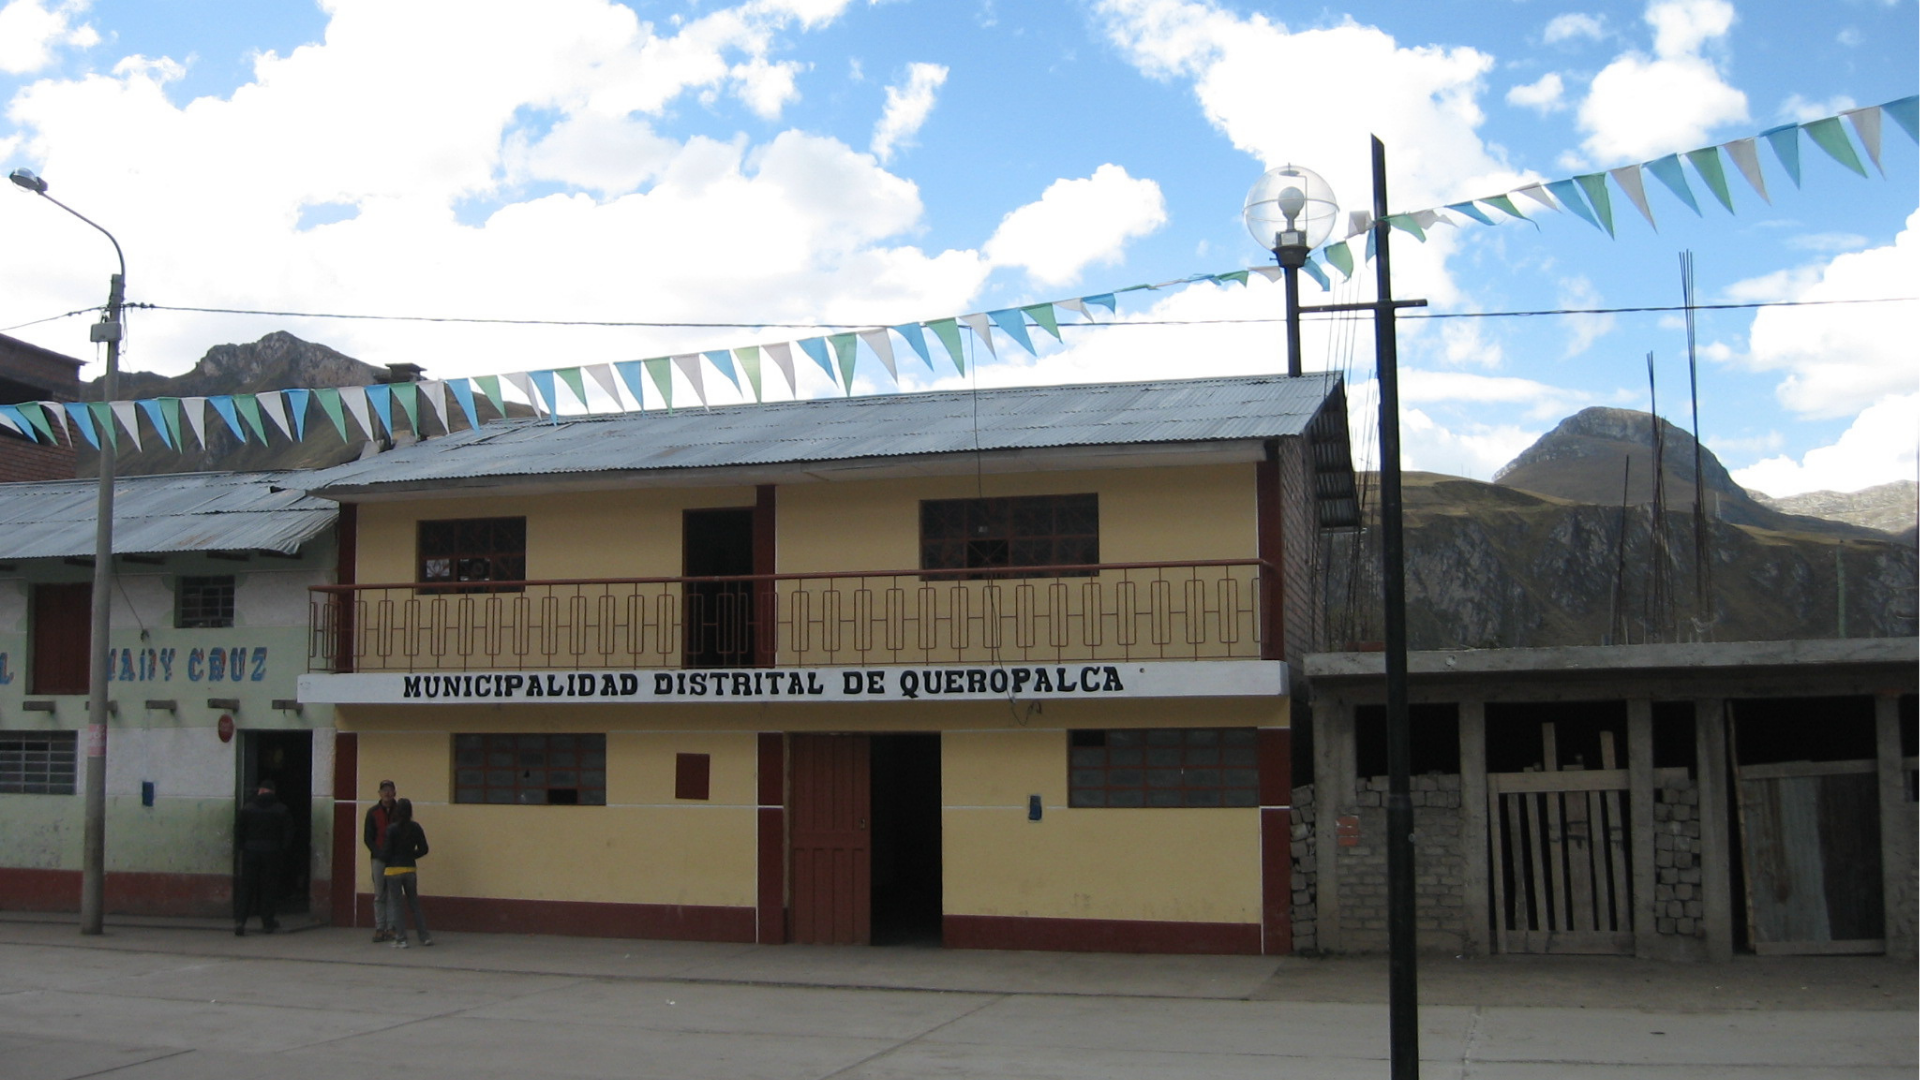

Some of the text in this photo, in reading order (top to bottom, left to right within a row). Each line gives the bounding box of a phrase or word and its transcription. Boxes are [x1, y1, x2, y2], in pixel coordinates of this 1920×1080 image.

[188, 647, 267, 682] CRUZ
[403, 666, 1124, 698] MUNICIPALIDAD DISTRITAL DE QUEROPALCA
